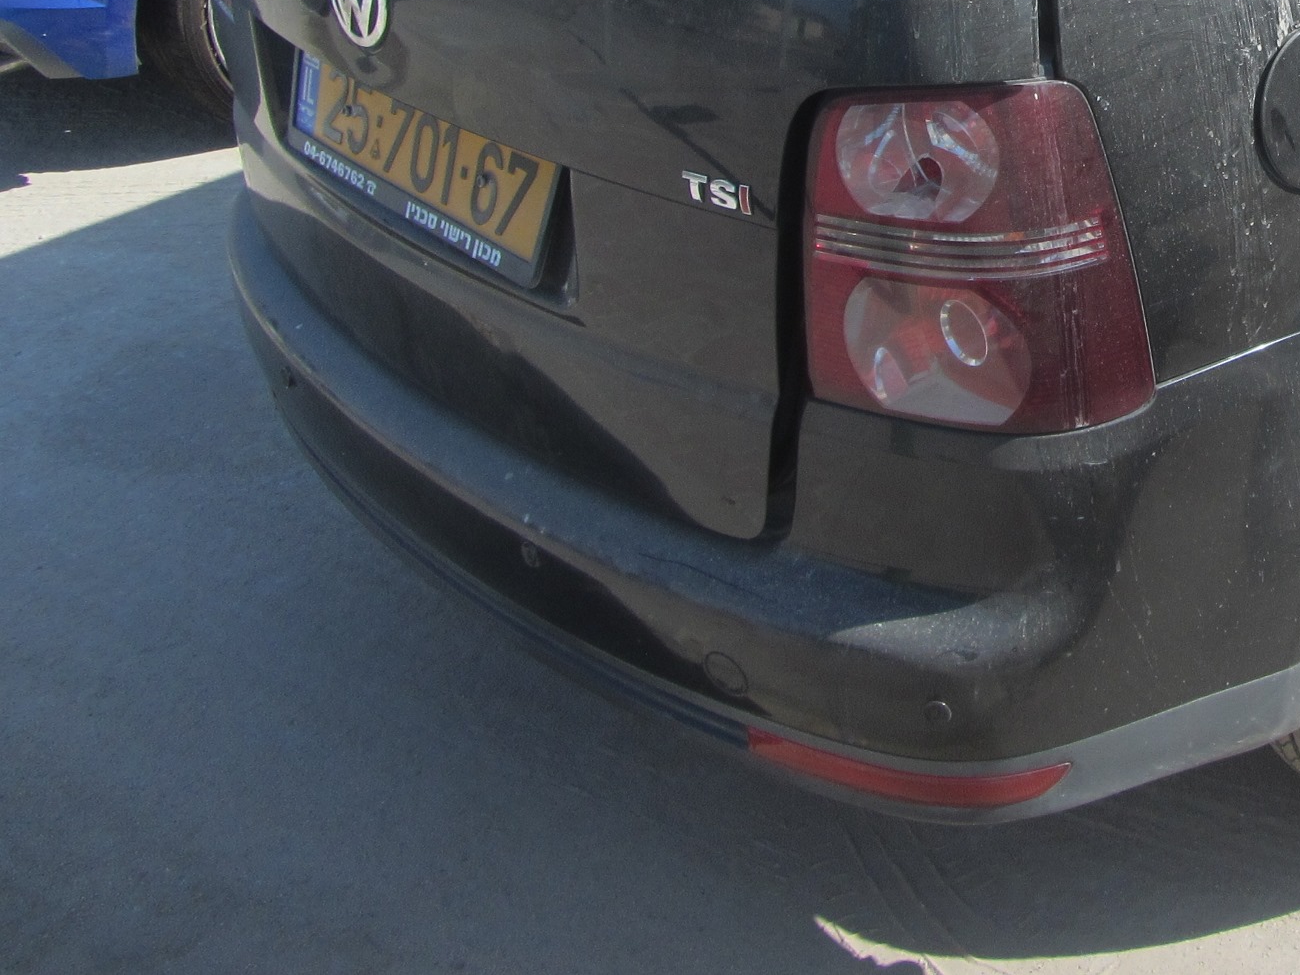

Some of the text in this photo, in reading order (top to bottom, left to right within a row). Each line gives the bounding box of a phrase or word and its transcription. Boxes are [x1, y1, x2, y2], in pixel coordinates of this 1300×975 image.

[681, 170, 751, 216] TSI
[405, 201, 502, 267] מכון רישוי סכנין
